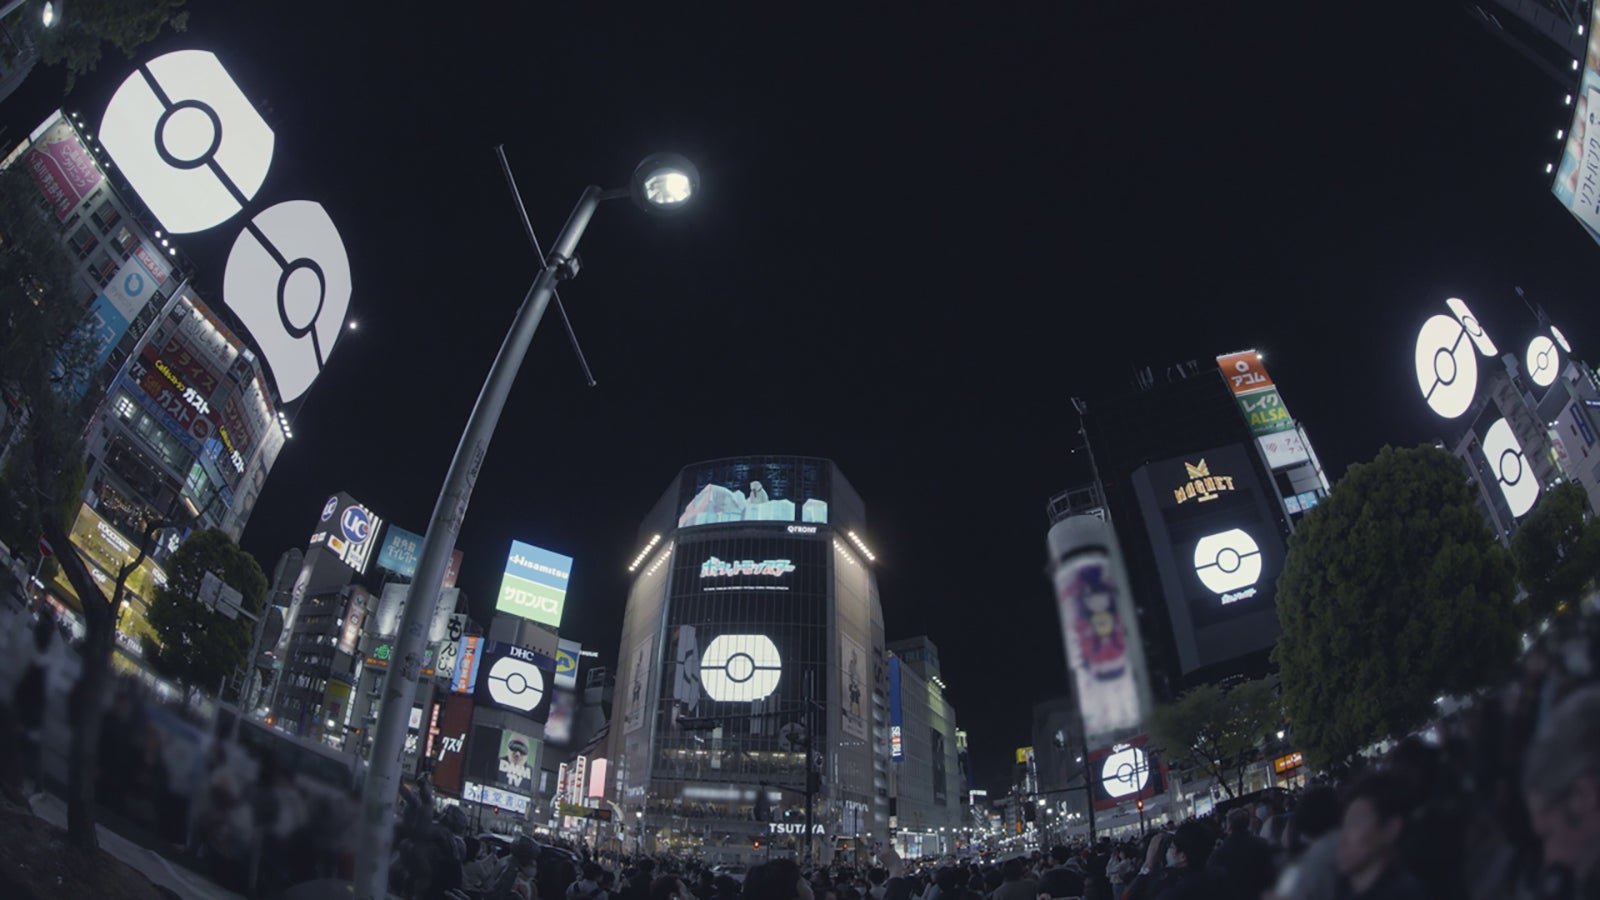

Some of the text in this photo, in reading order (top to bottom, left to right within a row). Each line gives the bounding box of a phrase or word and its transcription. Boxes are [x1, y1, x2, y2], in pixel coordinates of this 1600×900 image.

[131, 361, 148, 378] 7F
[1230, 372, 1267, 387] アコム
[156, 389, 190, 423] ガスト
[181, 386, 211, 415] ガスト
[1242, 394, 1278, 413] レイク
[1251, 407, 1288, 426] ALSA
[230, 449, 245, 474] ガスト
[343, 510, 367, 540] UC
[512, 554, 569, 580] Hisamitsu
[504, 585, 559, 616] サロンパス
[509, 645, 535, 661] DHC
